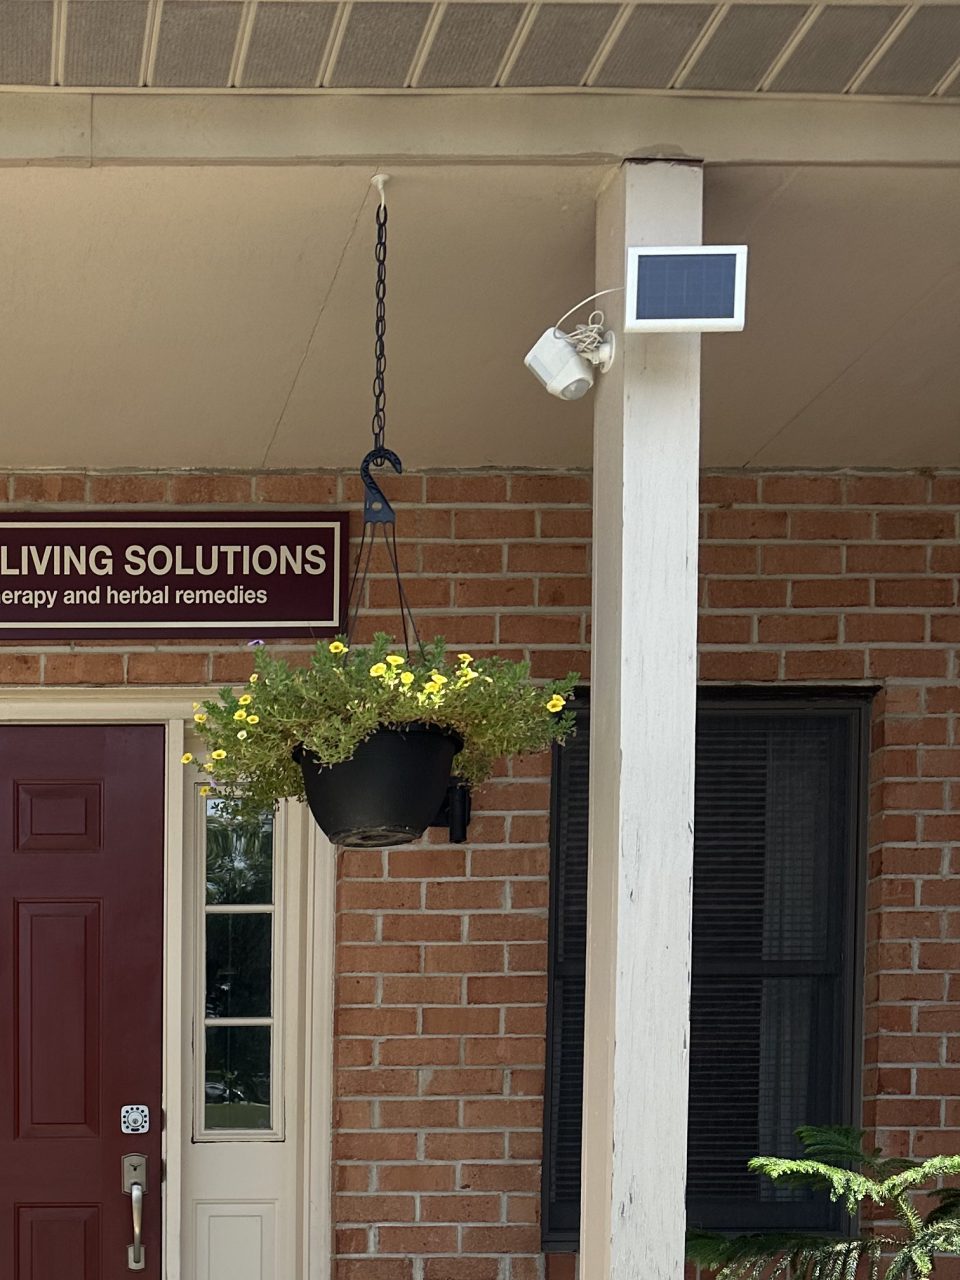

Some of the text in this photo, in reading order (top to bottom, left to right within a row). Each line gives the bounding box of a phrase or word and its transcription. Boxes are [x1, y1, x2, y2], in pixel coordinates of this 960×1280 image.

[0, 545, 113, 576] LIVING
[124, 544, 327, 576] SOLUTIONS
[63, 585, 100, 605] and
[106, 585, 169, 605] herbal
[175, 585, 268, 605] remedies
